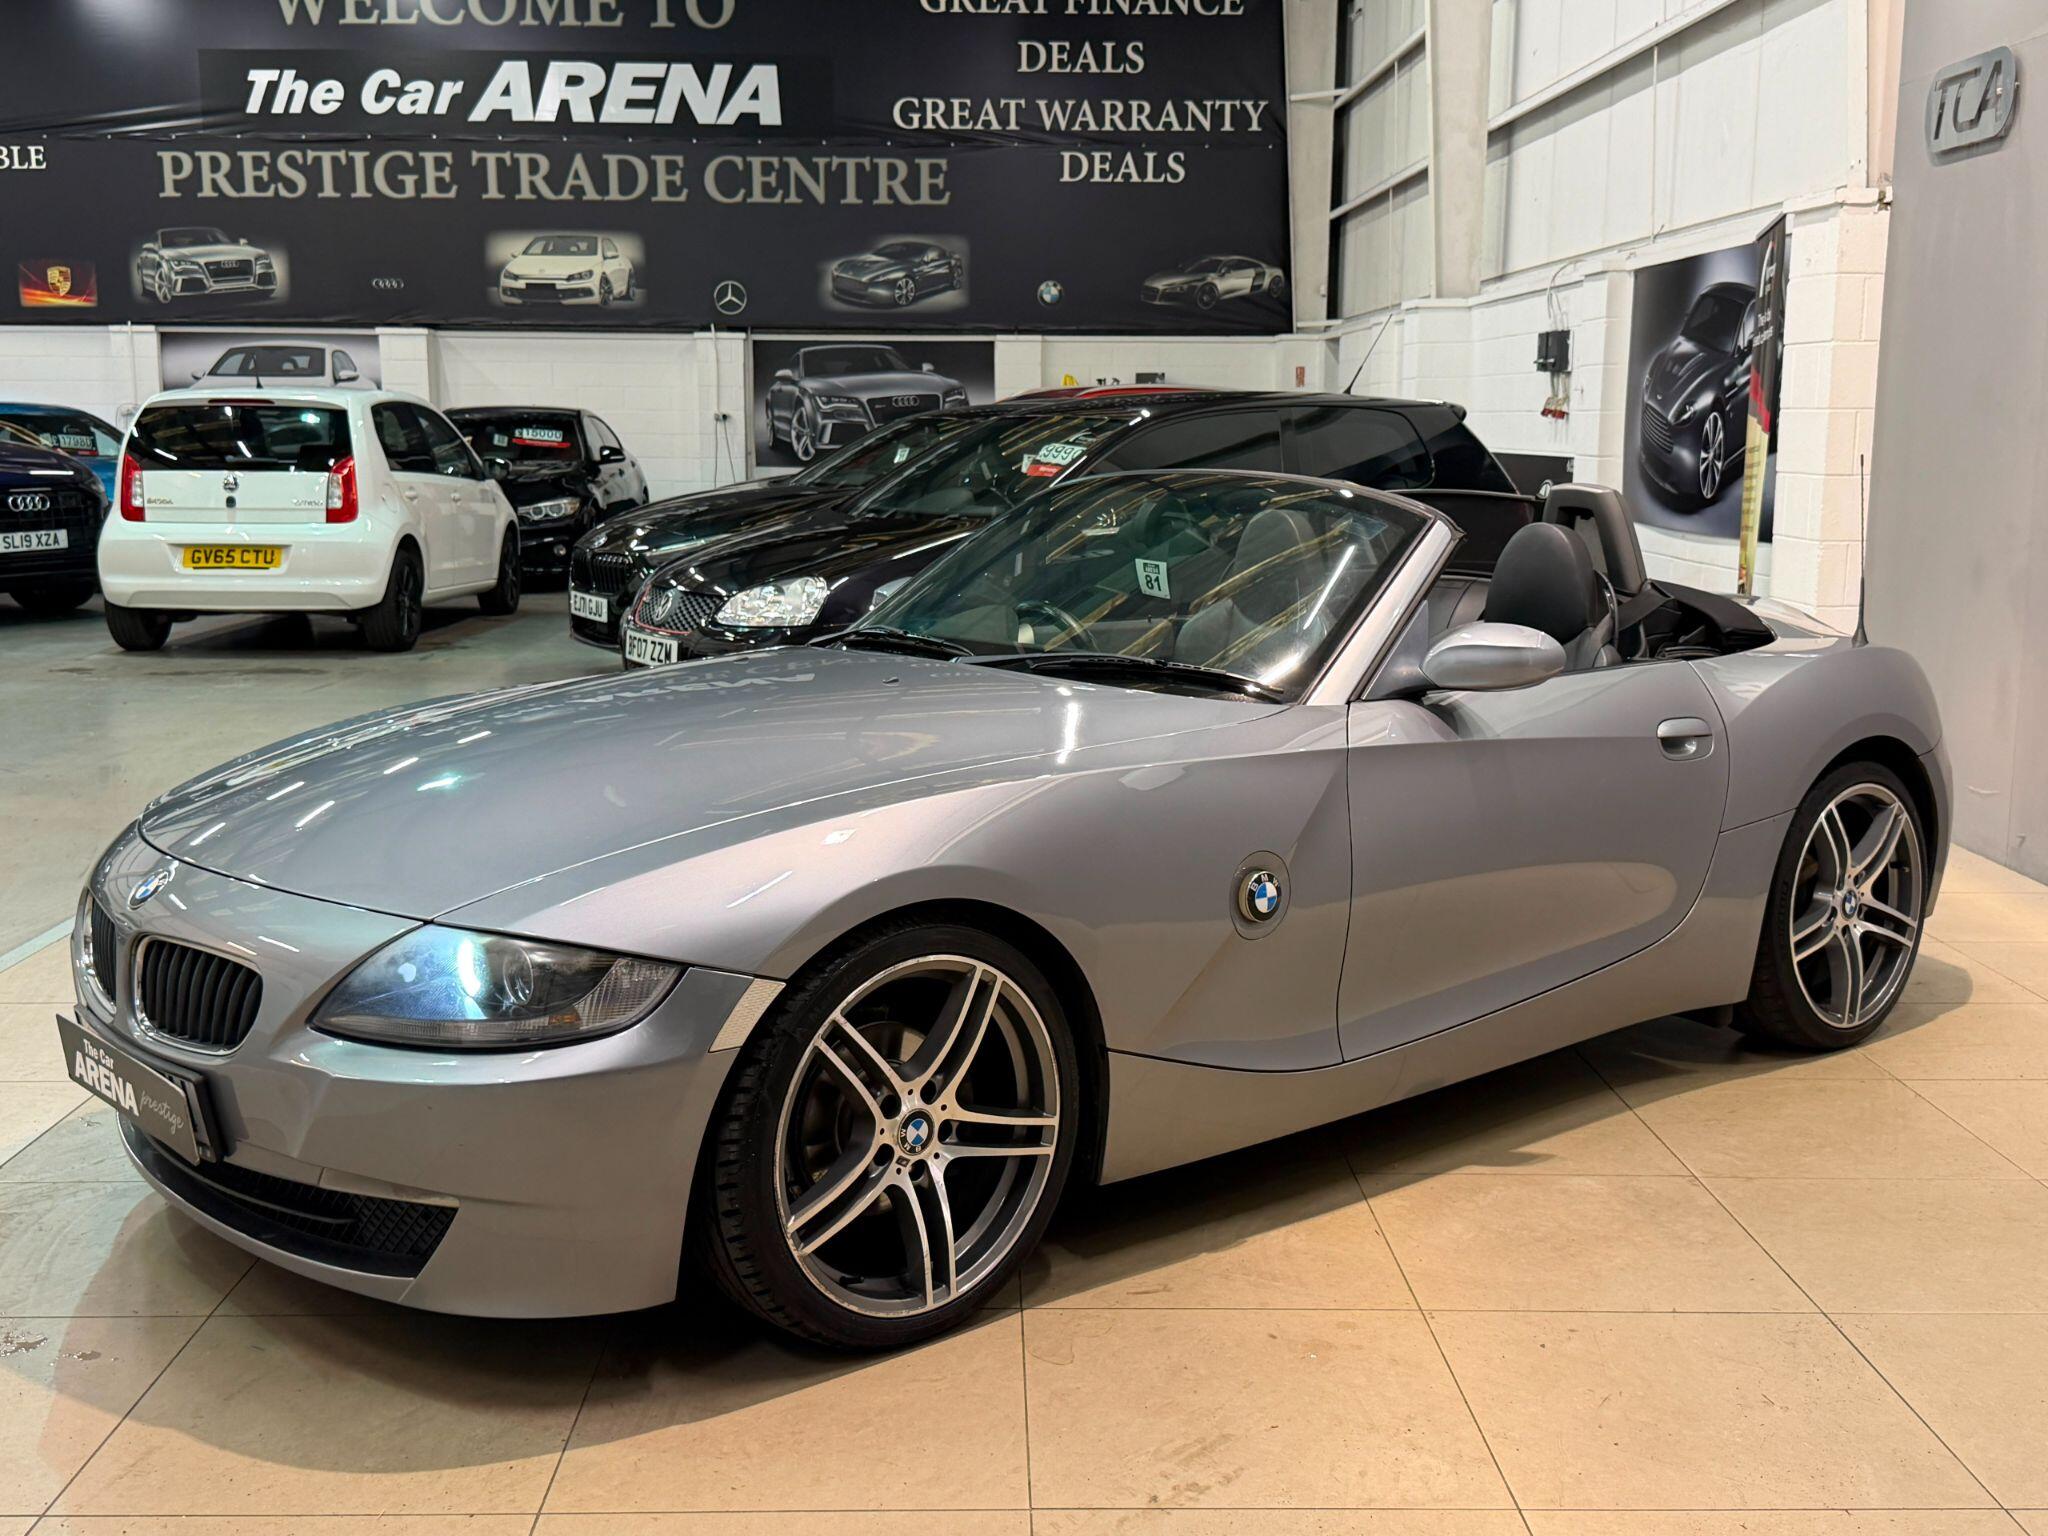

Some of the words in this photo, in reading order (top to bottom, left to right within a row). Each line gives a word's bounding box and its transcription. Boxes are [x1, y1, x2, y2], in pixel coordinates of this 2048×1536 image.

[1017, 41, 1145, 74] DEALS
[245, 69, 345, 115] The
[360, 68, 464, 115] Car
[467, 60, 782, 126] ARENA
[892, 97, 1026, 130] GREAT
[1035, 99, 1268, 132] WARRANTY
[156, 149, 458, 199] PRESTIGE
[471, 150, 689, 202] TRADE
[704, 155, 951, 206] CENTRE
[1059, 151, 1186, 184] DEALS
[2, 534, 32, 550] SL19
[35, 533, 61, 547] XZA
[191, 549, 235, 564] GV65
[240, 549, 275, 564] CTU
[1145, 574, 1162, 592] 81
[83, 1038, 100, 1059] The
[99, 1048, 115, 1068] Car
[75, 1051, 140, 1117] ARENA
[140, 1090, 184, 1134] prestige
